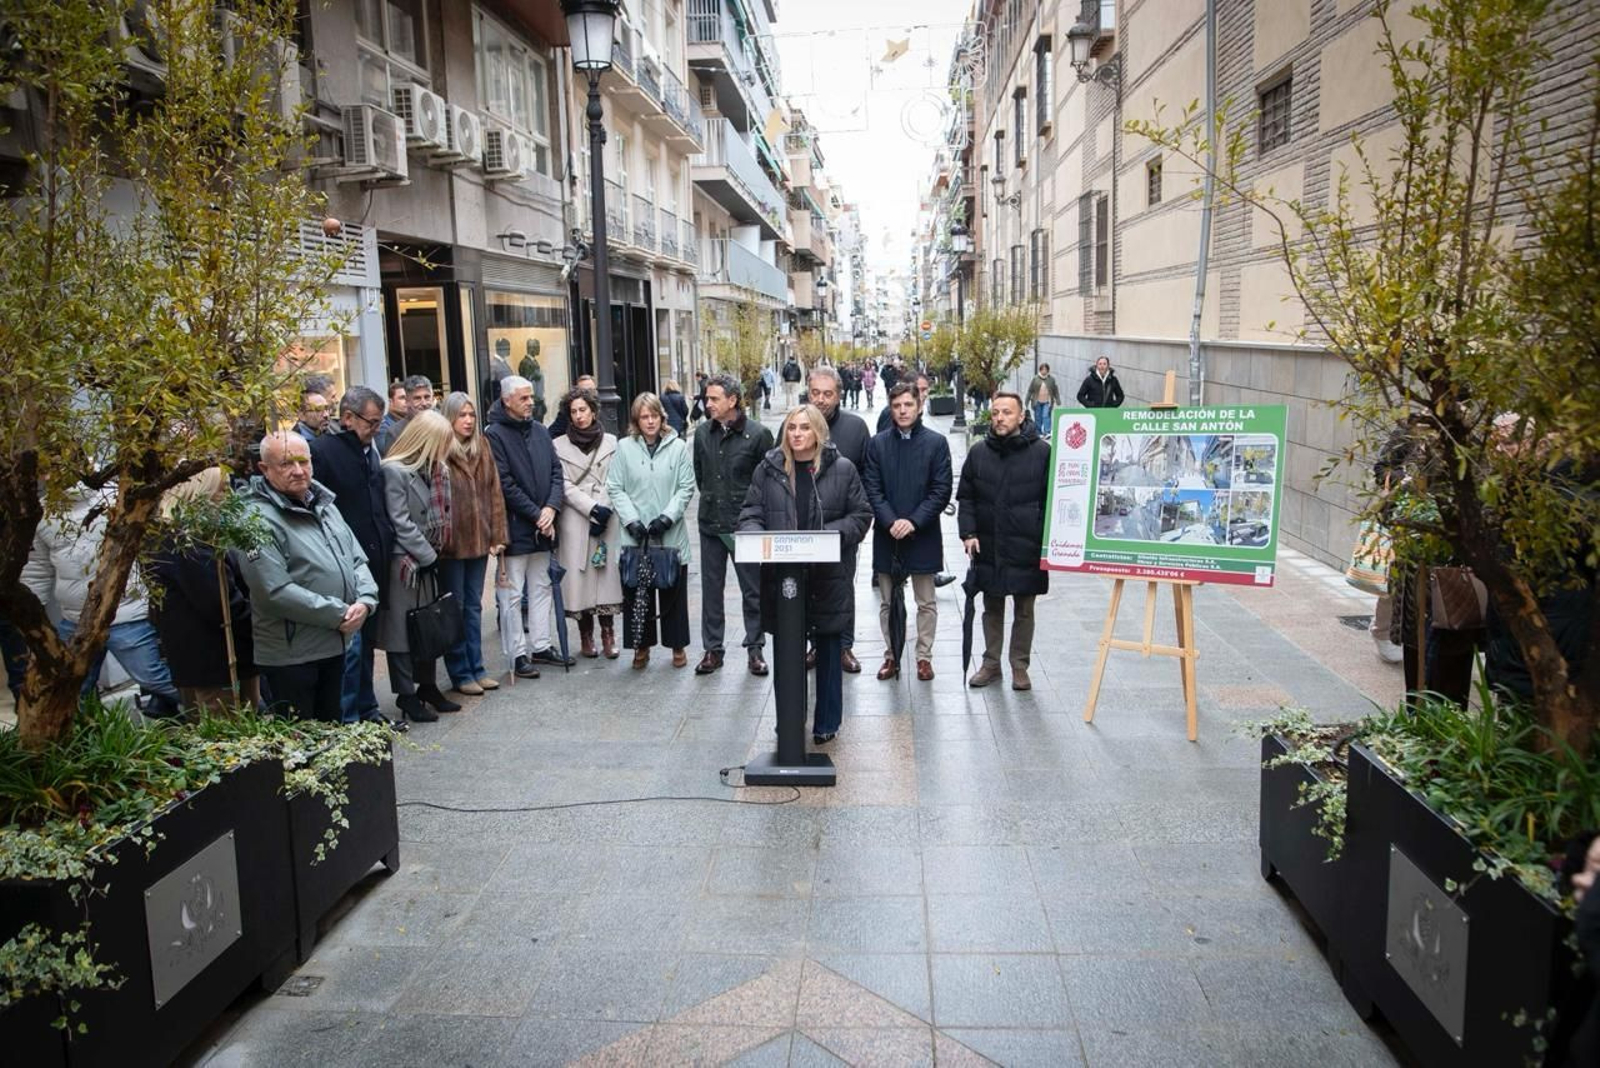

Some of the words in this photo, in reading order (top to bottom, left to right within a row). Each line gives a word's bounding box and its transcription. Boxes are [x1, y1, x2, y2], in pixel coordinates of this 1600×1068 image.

[1123, 408, 1216, 420] REMODELACIÓN
[1220, 409, 1235, 420] DE
[1239, 409, 1255, 419] LA
[1133, 422, 1170, 431] CALLE
[1173, 422, 1197, 431] SAN
[1200, 420, 1243, 431] ANTÓN
